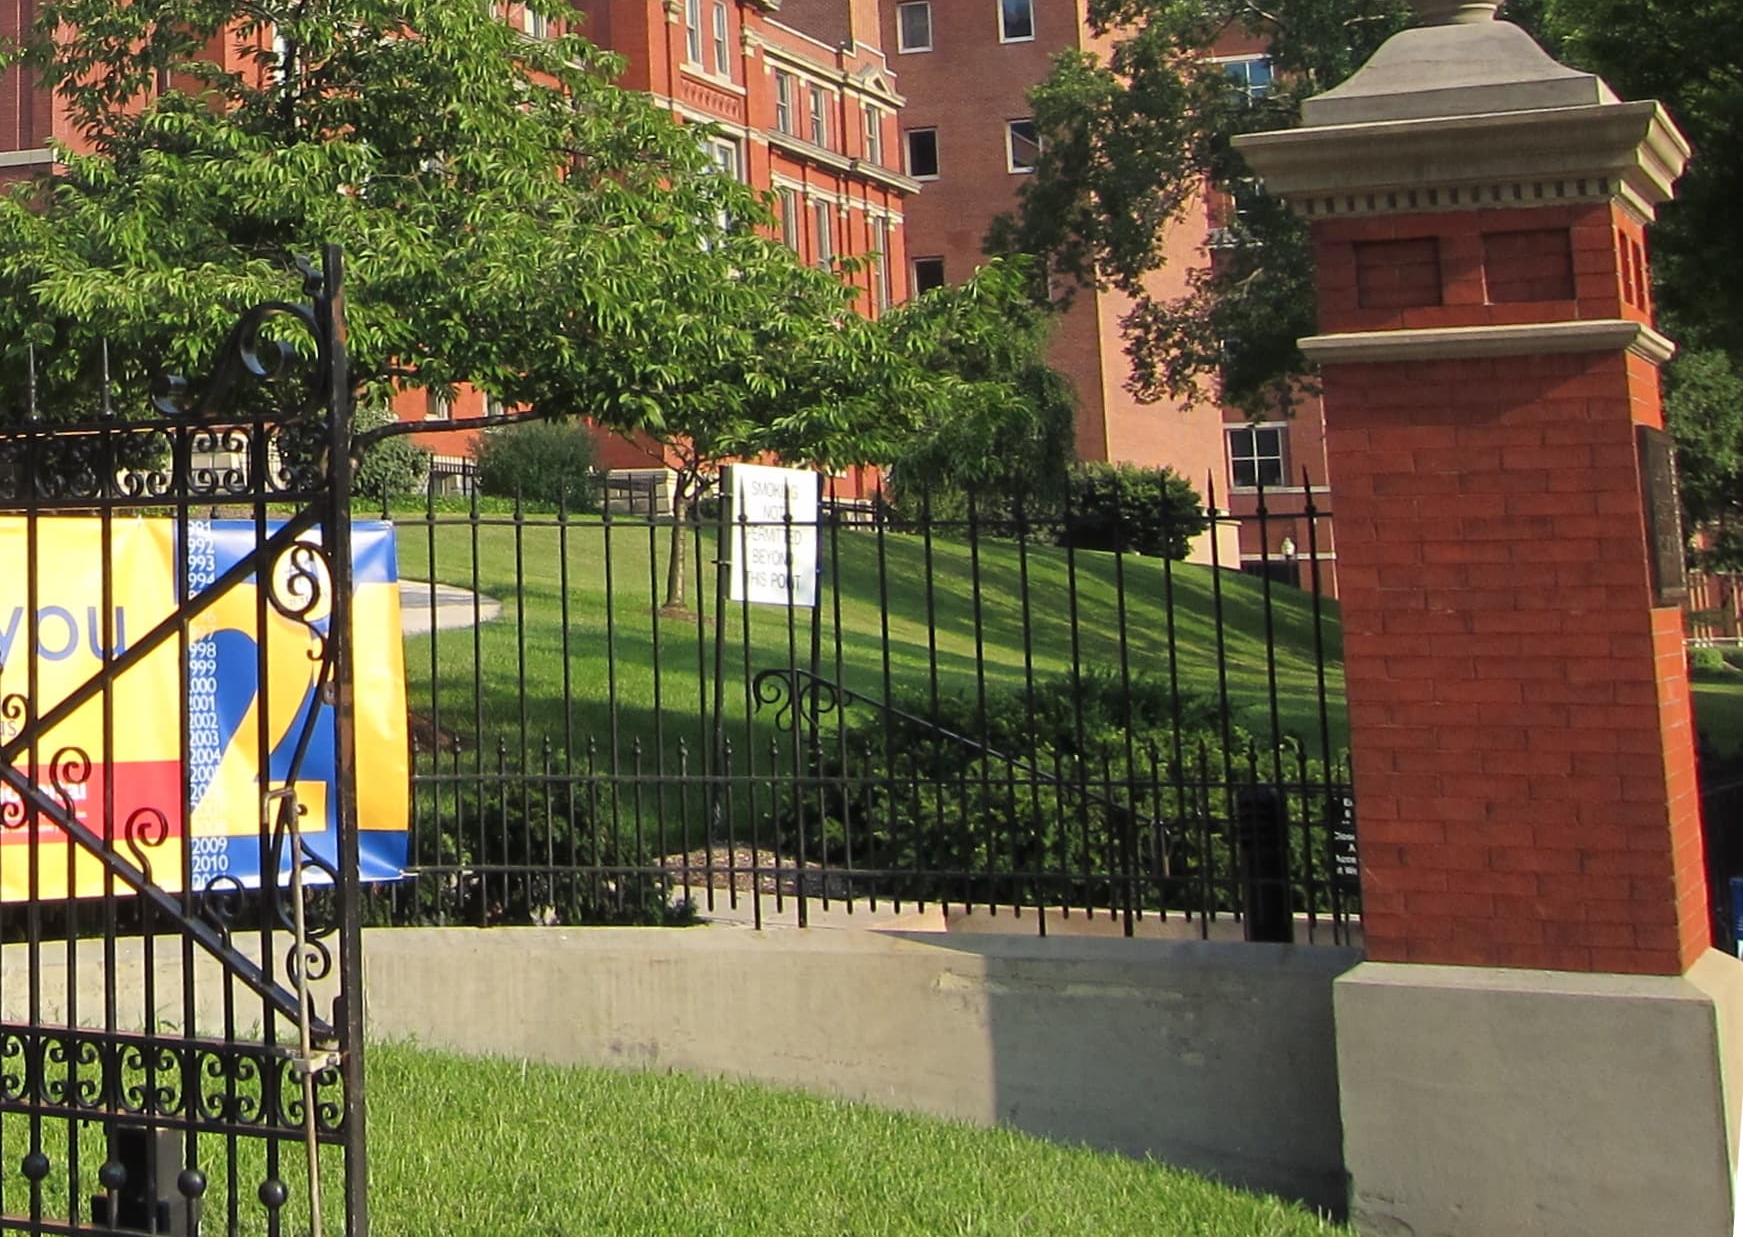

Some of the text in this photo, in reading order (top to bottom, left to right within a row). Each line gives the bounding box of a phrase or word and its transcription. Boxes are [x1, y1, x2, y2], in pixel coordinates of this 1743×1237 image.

[751, 481, 799, 500] SMOKIG
[763, 505, 788, 521] NOT
[745, 525, 802, 546] PERMITED
[188, 538, 215, 555] 992
[188, 555, 215, 572] 993
[752, 548, 793, 566] BEYON
[188, 572, 215, 589] 994
[770, 573, 801, 591] POT
[188, 642, 217, 659] 998
[189, 659, 217, 676] 999
[189, 676, 217, 694] 000
[189, 729, 220, 747] 2003
[191, 837, 228, 855] 2009
[191, 854, 229, 873] 2010
